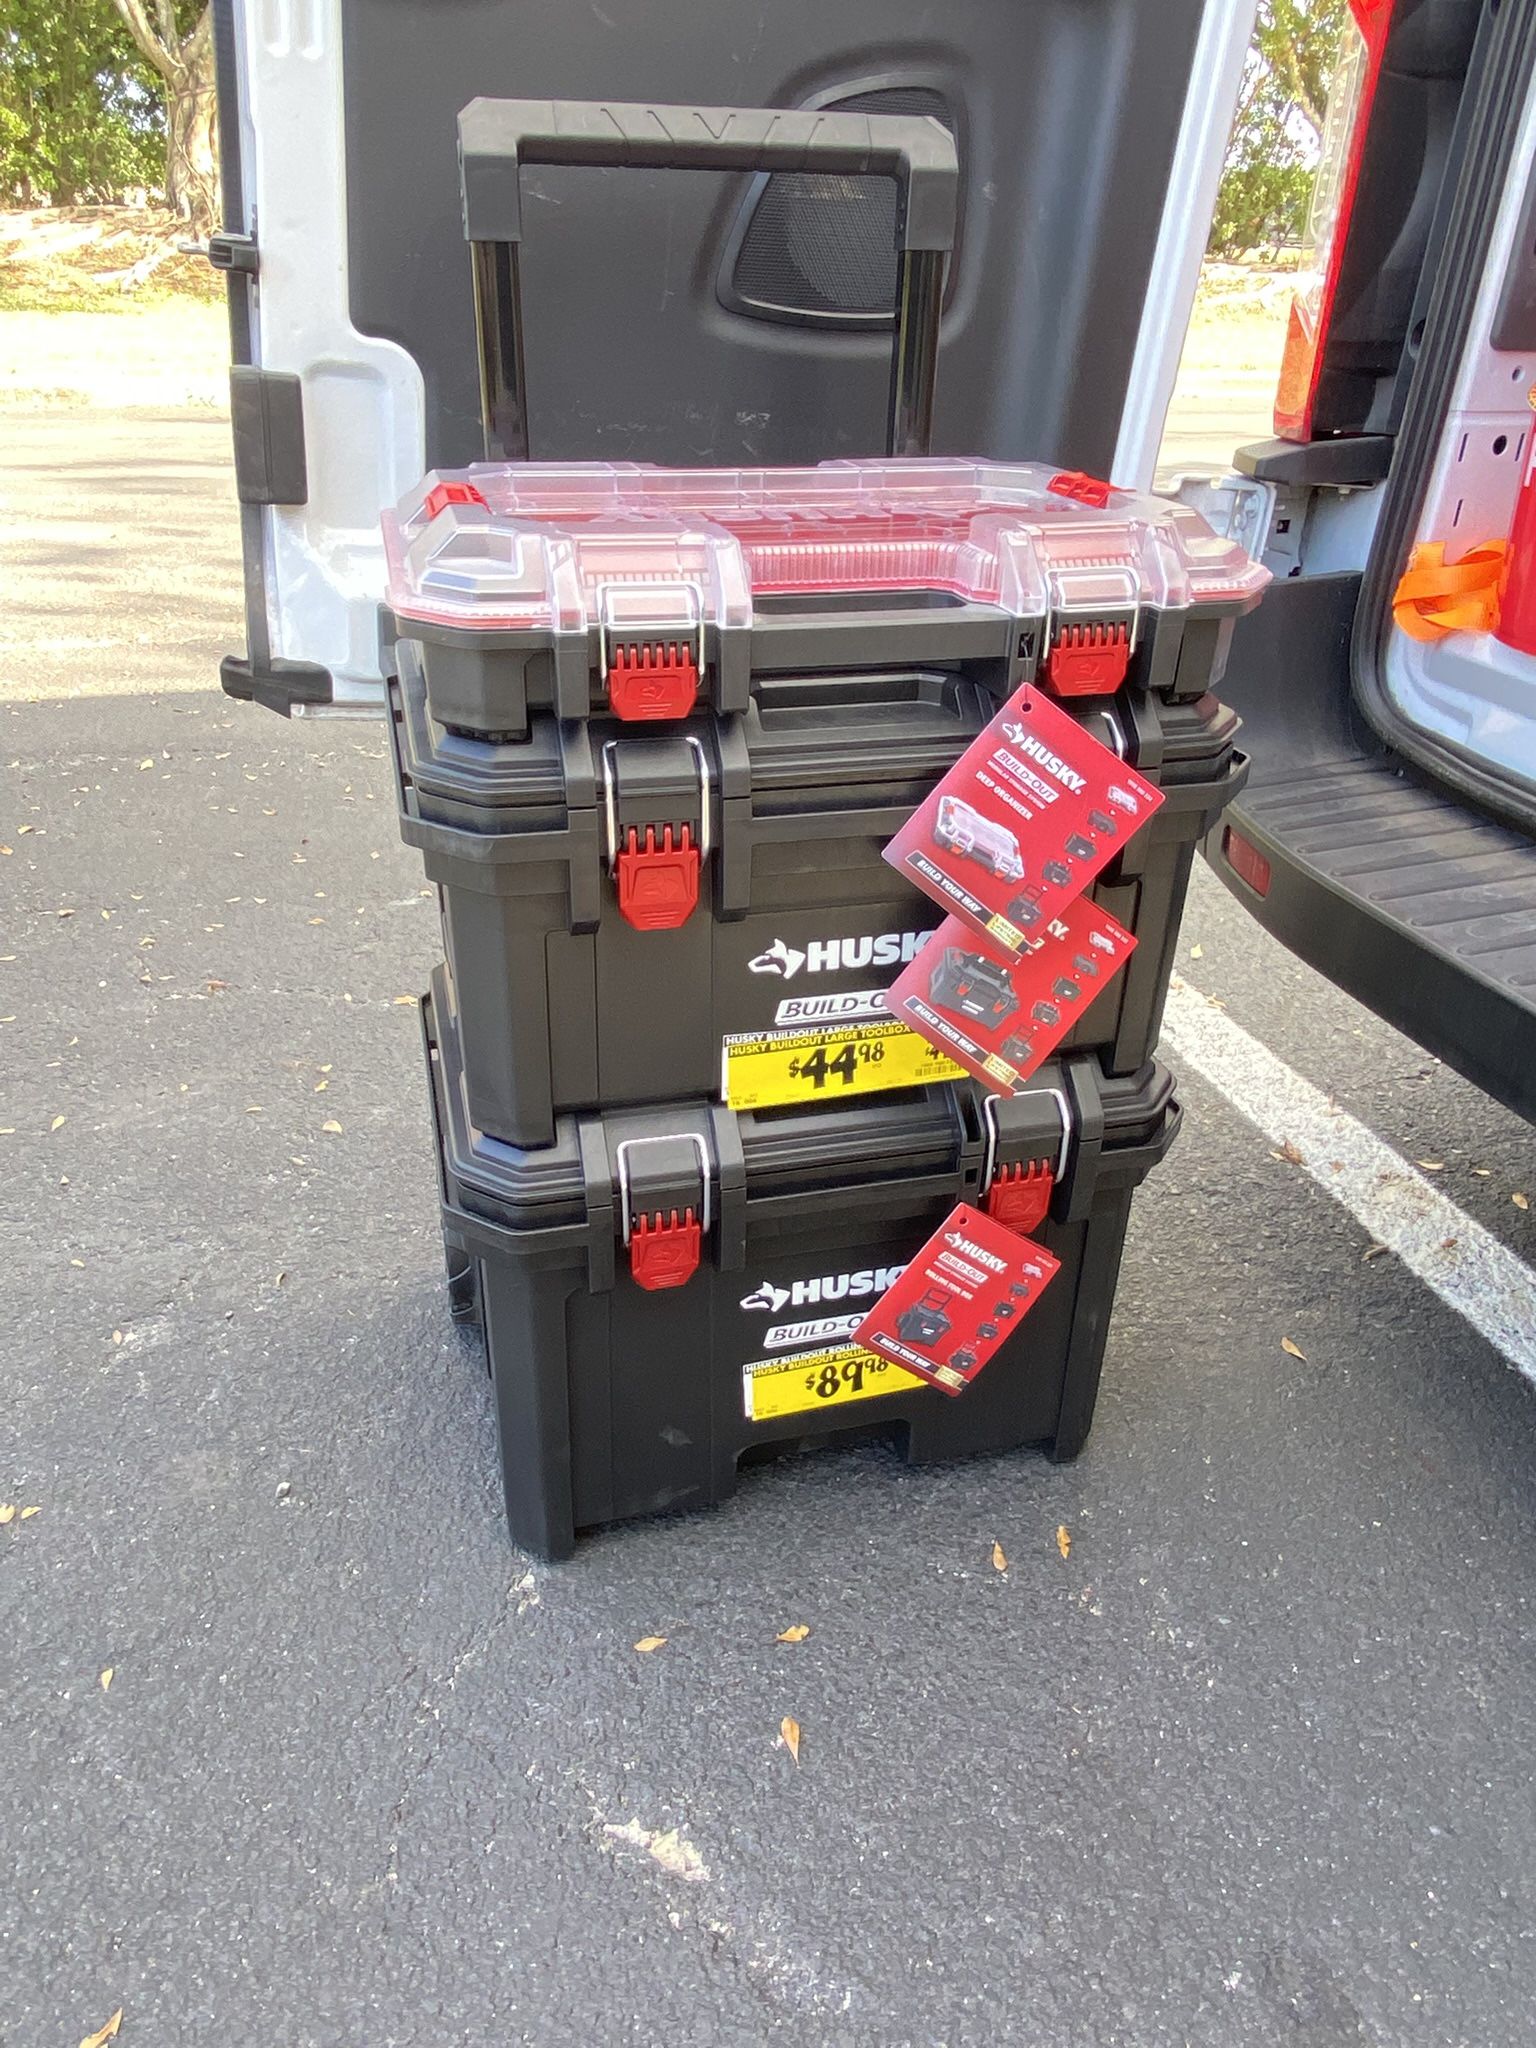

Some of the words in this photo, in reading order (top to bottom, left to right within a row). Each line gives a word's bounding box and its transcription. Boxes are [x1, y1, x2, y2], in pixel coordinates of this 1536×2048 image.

[996, 751, 1057, 800] BUILD-OUT
[1020, 735, 1087, 792] HUSKY
[975, 770, 995, 787] DEEP
[993, 785, 1033, 820] ORGANIZER
[917, 859, 942, 881] BUILD
[940, 878, 964, 900] YOUR
[961, 895, 982, 912] WAY
[807, 930, 936, 972] HUSK
[729, 1045, 767, 1056] HUSKY
[769, 1036, 823, 1051] BUILDOUT
[825, 1031, 858, 1043] LARGE
[861, 1024, 911, 1038] TOOLBOX
[913, 1004, 940, 1025] BUILD
[937, 1021, 961, 1042] YOUR
[957, 1037, 978, 1053] WAY
[941, 1253, 986, 1282] BUILD-OUT
[960, 1240, 1008, 1272] HUSKY
[792, 1264, 907, 1305] HUSK
[769, 1316, 864, 1342] BUILD-O
[879, 1337, 900, 1353] BUILD
[899, 1348, 917, 1361] YOUR
[753, 1366, 787, 1378] HUSKY
[788, 1355, 834, 1370] BUILDOUT
